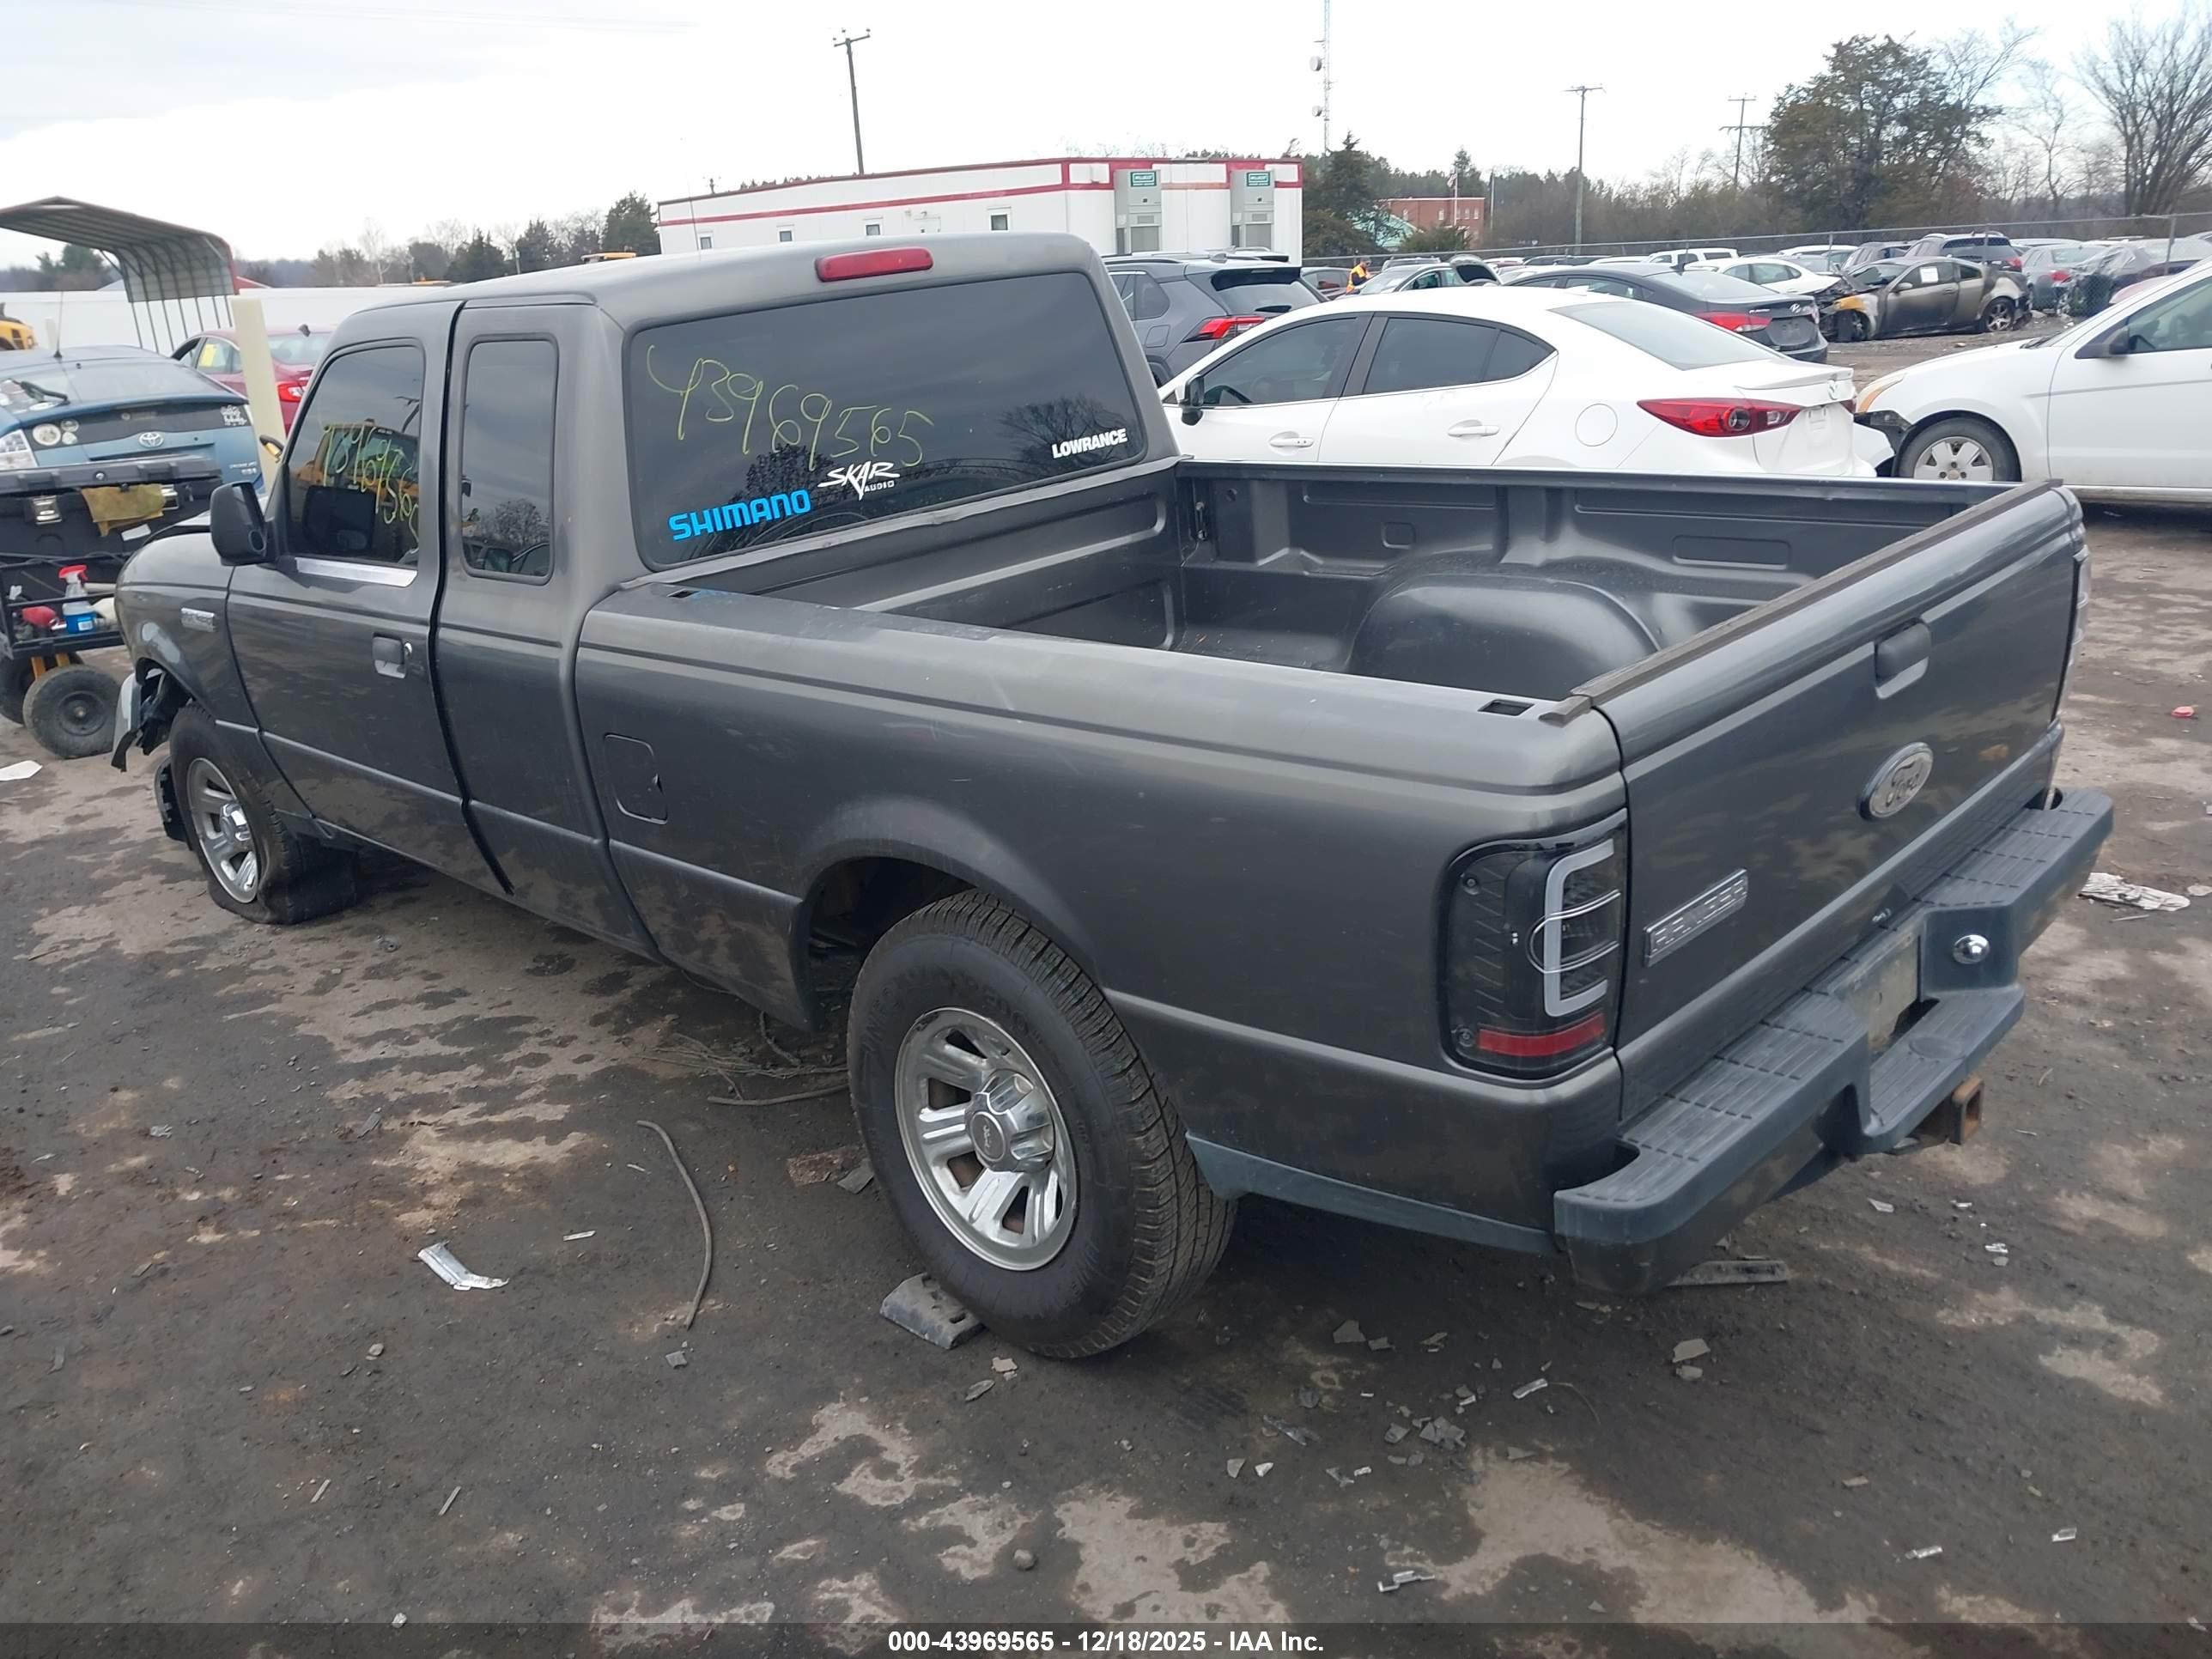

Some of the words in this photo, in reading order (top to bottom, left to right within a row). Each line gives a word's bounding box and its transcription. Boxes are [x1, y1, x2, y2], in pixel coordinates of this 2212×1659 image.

[647, 344, 934, 471] 43969565
[1052, 428, 1127, 459] LOWRANCE
[817, 461, 901, 501] SKAR
[865, 480, 895, 492] AUDIO
[669, 489, 811, 541] SHIMANO
